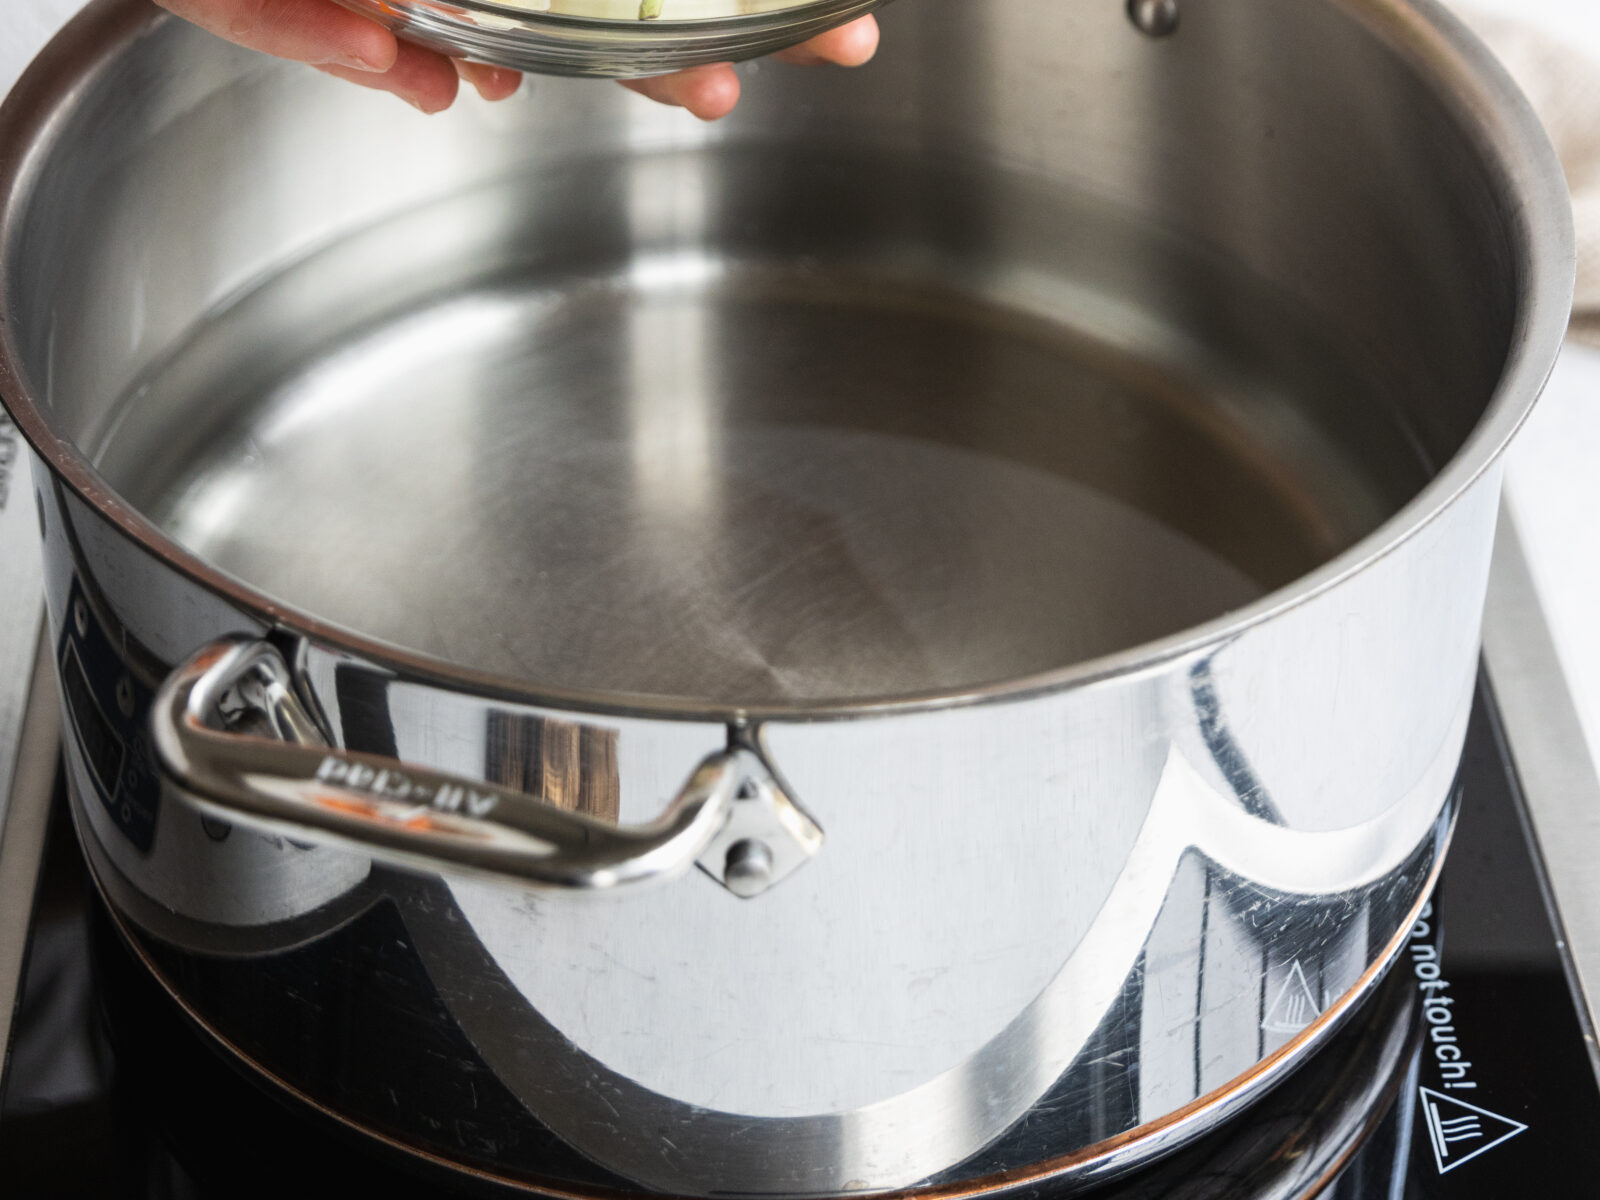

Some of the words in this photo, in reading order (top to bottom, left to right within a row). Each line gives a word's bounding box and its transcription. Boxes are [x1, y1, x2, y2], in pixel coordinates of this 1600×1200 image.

[316, 756, 498, 816] All-Clad
[1410, 945, 1450, 991] not
[1422, 995, 1478, 1089] touch!
